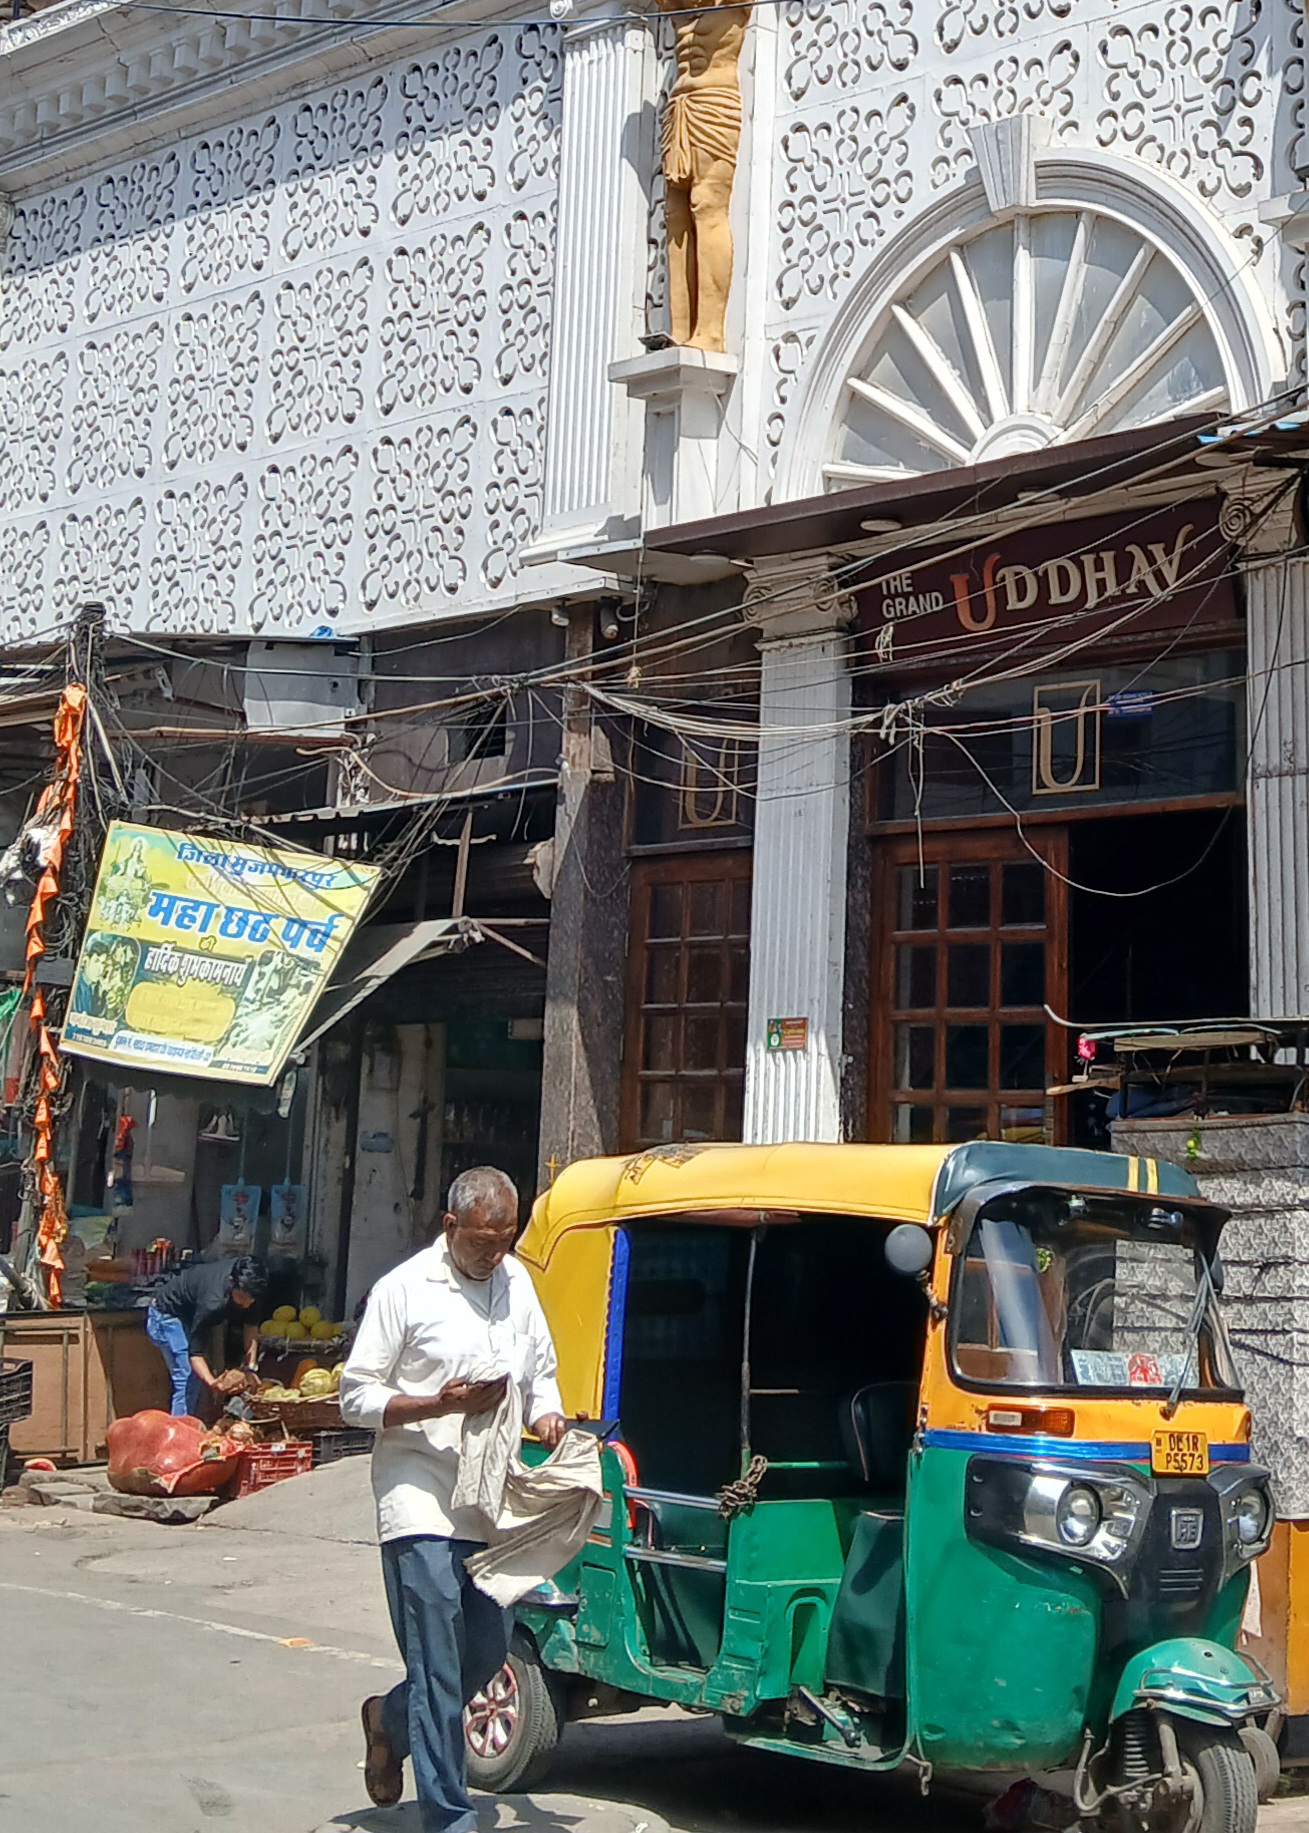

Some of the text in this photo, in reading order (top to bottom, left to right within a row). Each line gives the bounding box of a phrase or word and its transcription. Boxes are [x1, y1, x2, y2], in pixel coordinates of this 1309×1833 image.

[881, 572, 914, 596] THE
[949, 523, 1195, 632] UDDHAV
[881, 591, 945, 619] GRAND
[148, 891, 345, 953] महा छठ पर्व
[143, 941, 181, 976] हार्दिक
[1165, 1453, 1205, 1472] P5573
